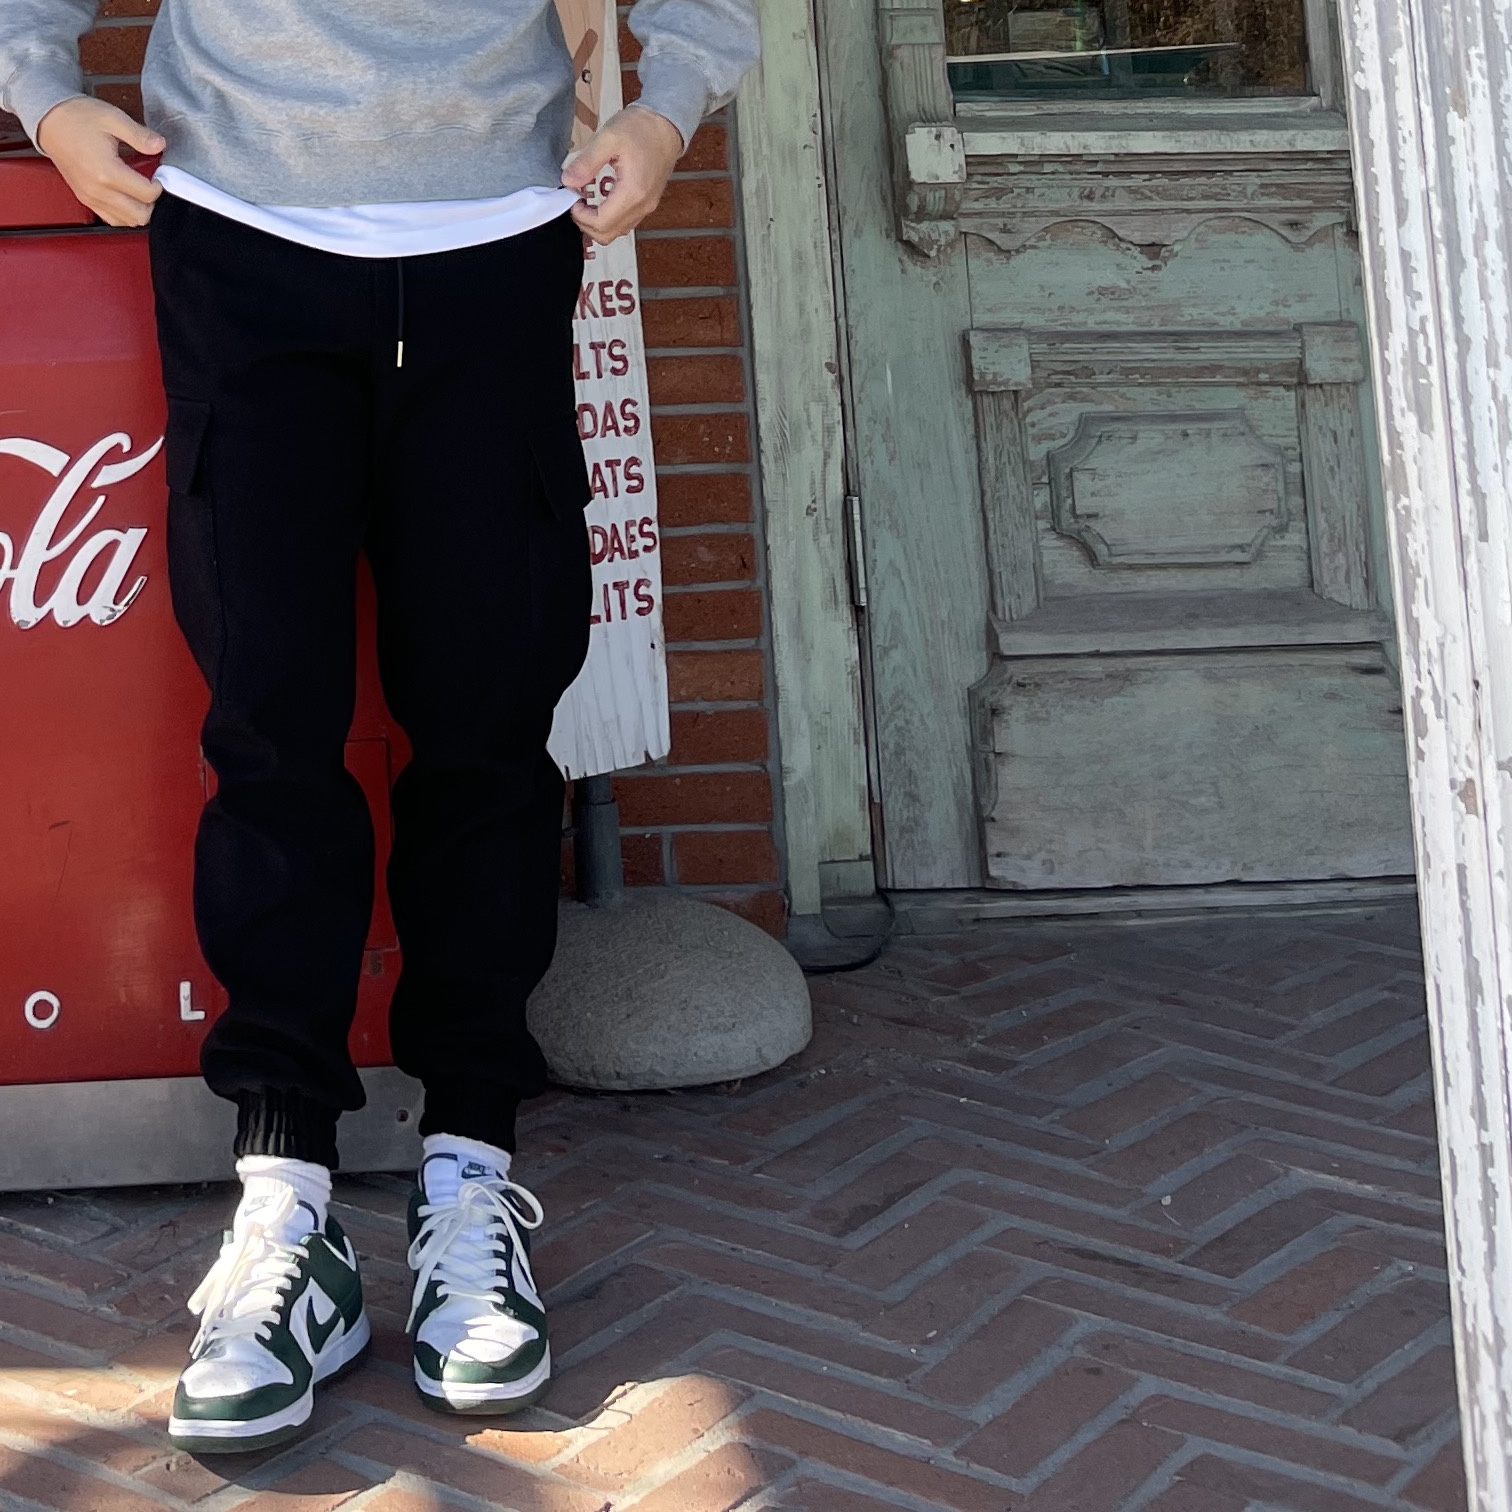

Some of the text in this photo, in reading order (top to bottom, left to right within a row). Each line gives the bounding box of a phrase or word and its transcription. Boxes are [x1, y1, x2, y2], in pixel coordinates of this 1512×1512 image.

[573, 279, 636, 320] KES
[574, 339, 629, 380] LTS
[576, 397, 640, 440] DAS
[591, 455, 645, 500] ATS
[590, 516, 657, 566] DAES
[589, 578, 655, 625] ITS
